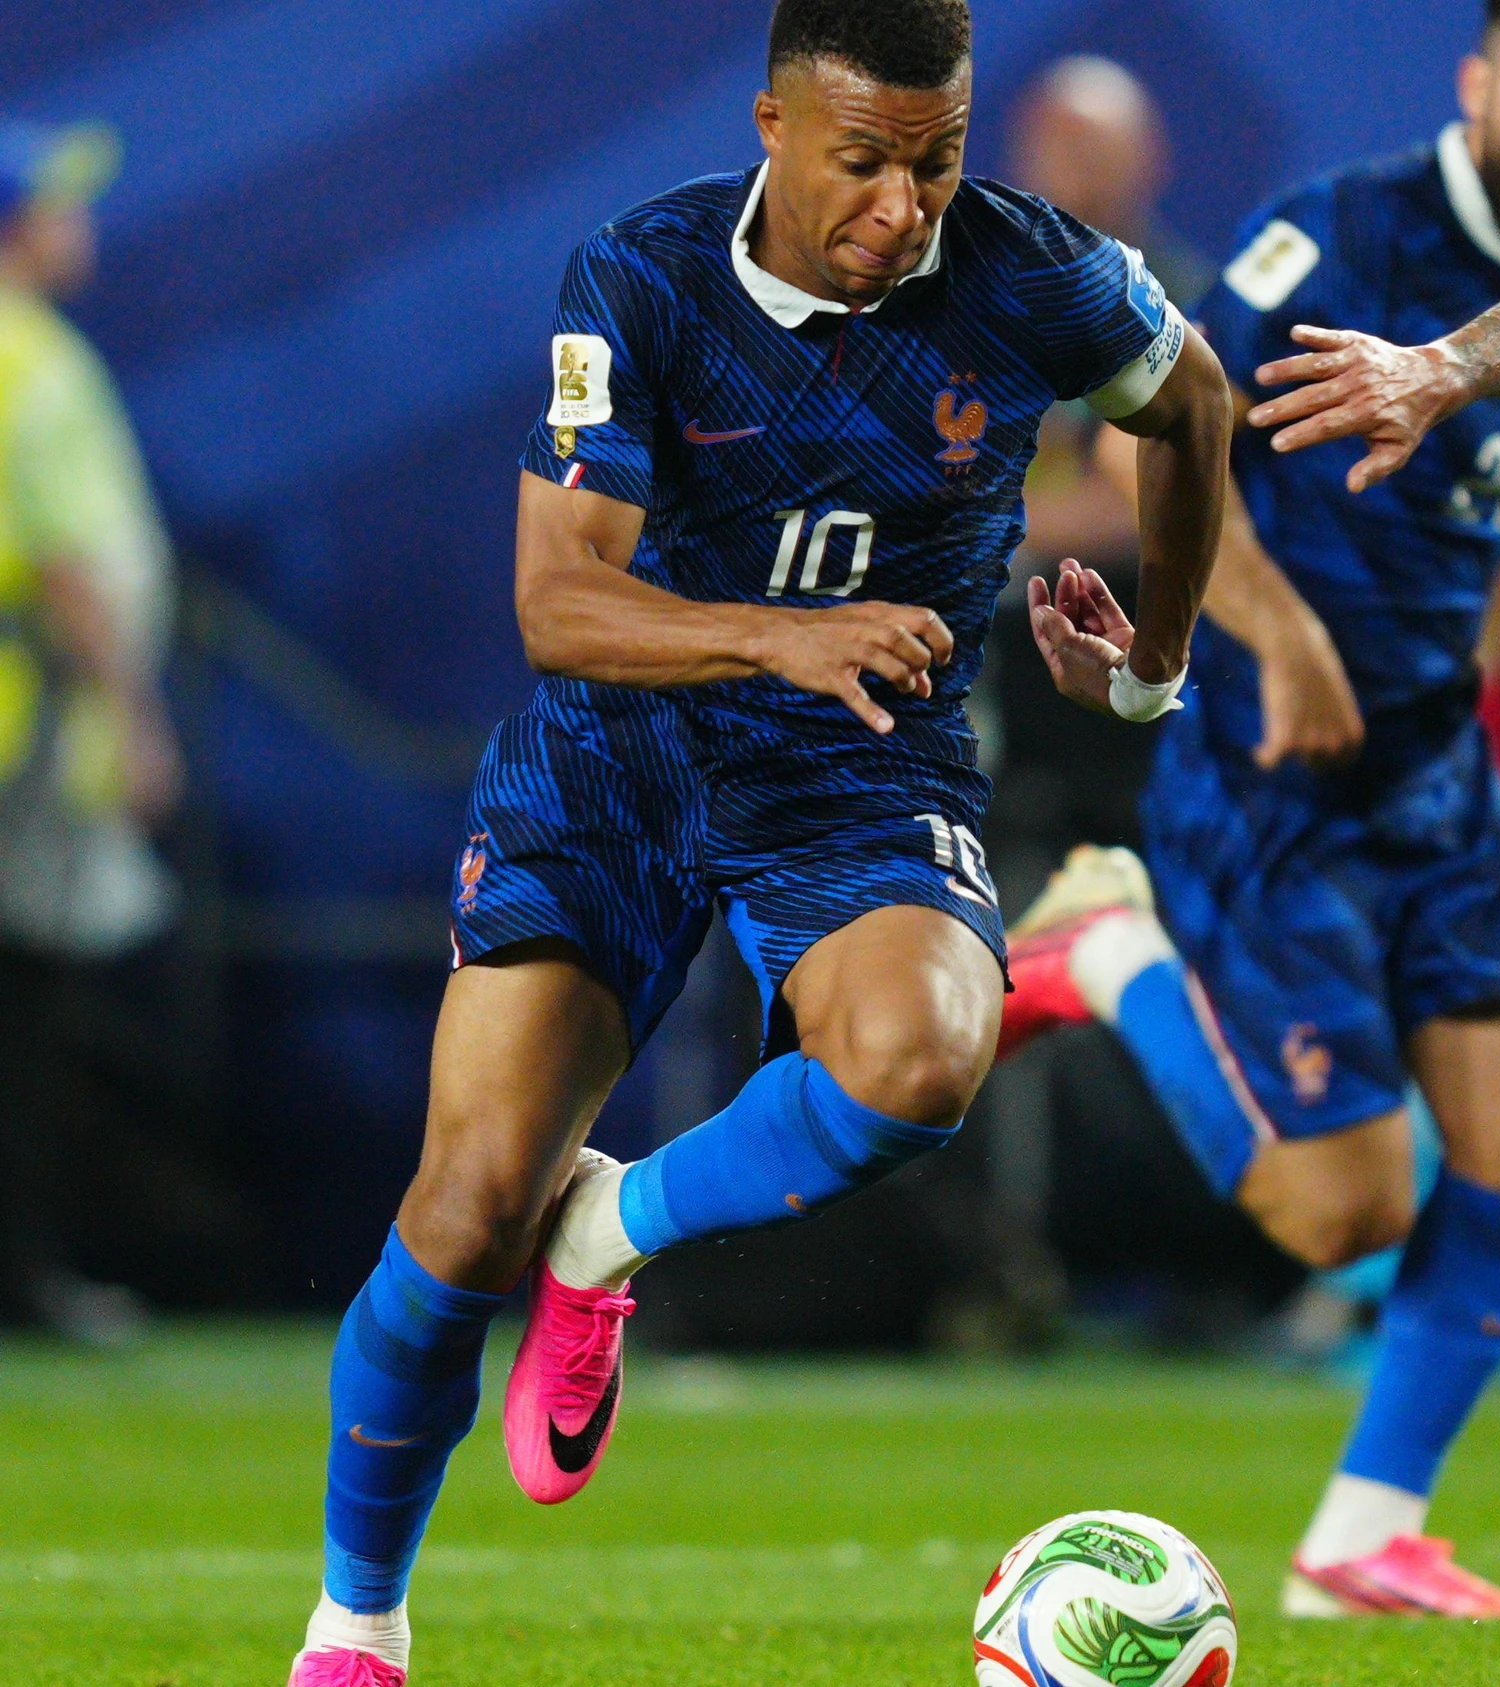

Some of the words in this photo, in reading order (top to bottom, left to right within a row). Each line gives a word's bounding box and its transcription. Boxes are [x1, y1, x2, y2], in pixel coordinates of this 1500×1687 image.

[1168, 326, 1181, 359] FIFA
[562, 388, 580, 397] FIFA
[765, 509, 876, 597] 10
[914, 813, 999, 908] 10
[1083, 1525, 1155, 1560] TRIONDA
